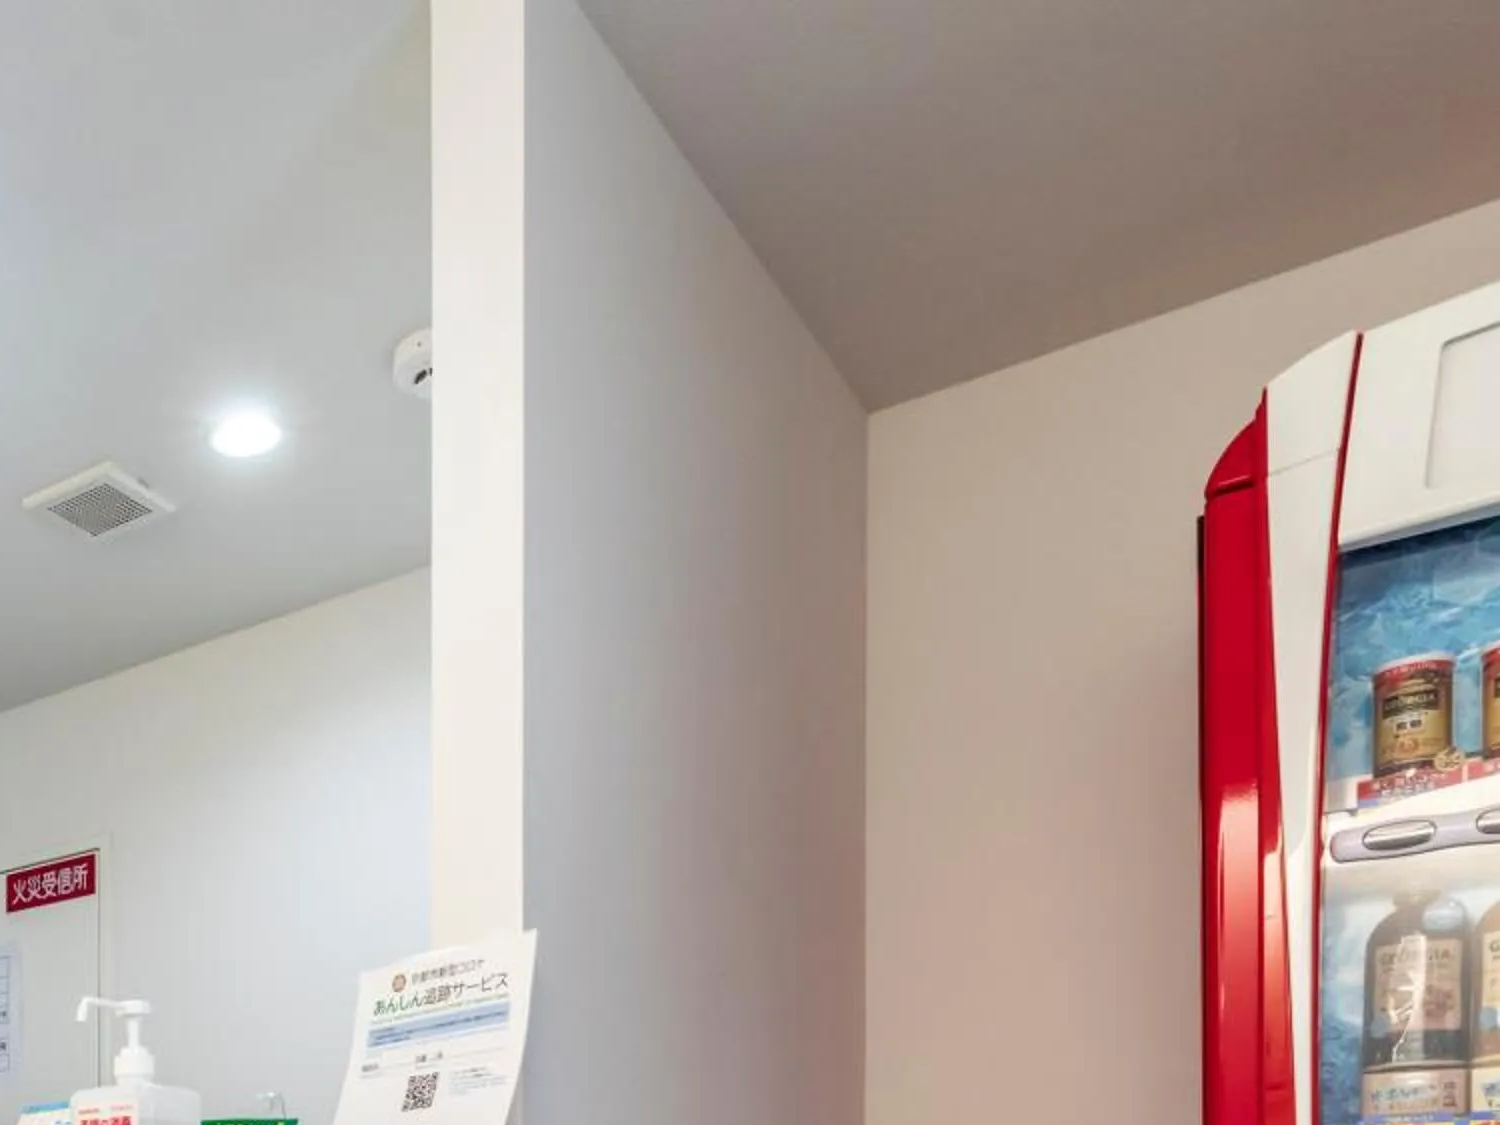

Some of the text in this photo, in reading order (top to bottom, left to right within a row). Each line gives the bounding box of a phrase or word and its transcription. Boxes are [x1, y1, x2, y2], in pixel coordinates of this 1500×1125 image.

[11, 863, 89, 905] 火災受信所
[373, 972, 509, 1016] あんしん追跡サービス
